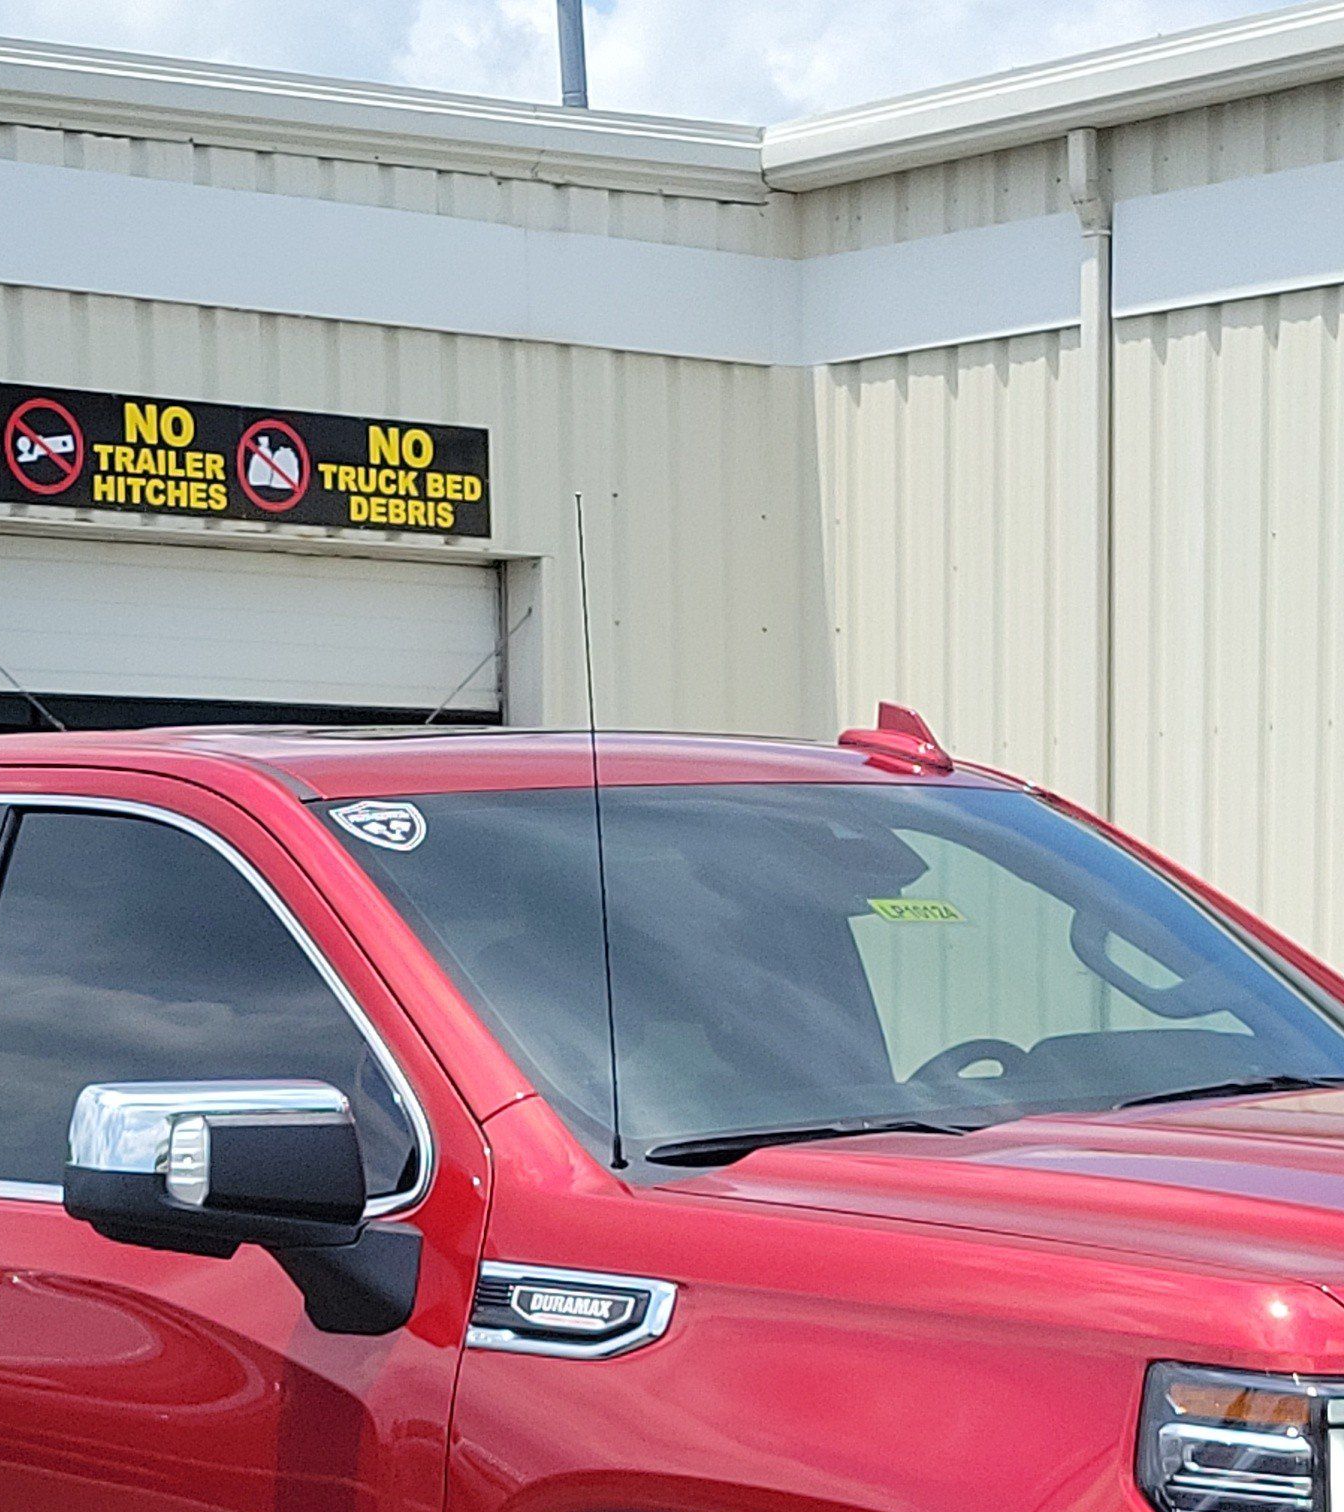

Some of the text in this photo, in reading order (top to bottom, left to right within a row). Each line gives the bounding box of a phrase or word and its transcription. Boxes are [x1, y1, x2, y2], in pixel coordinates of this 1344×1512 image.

[124, 402, 195, 447] NO
[93, 444, 226, 480] TRAILER
[368, 425, 434, 469] NO
[93, 474, 228, 511] HITCHES
[318, 463, 482, 501] TRUCK BED
[350, 496, 455, 529] DEBRIS
[529, 1292, 613, 1319] DURAMAX
